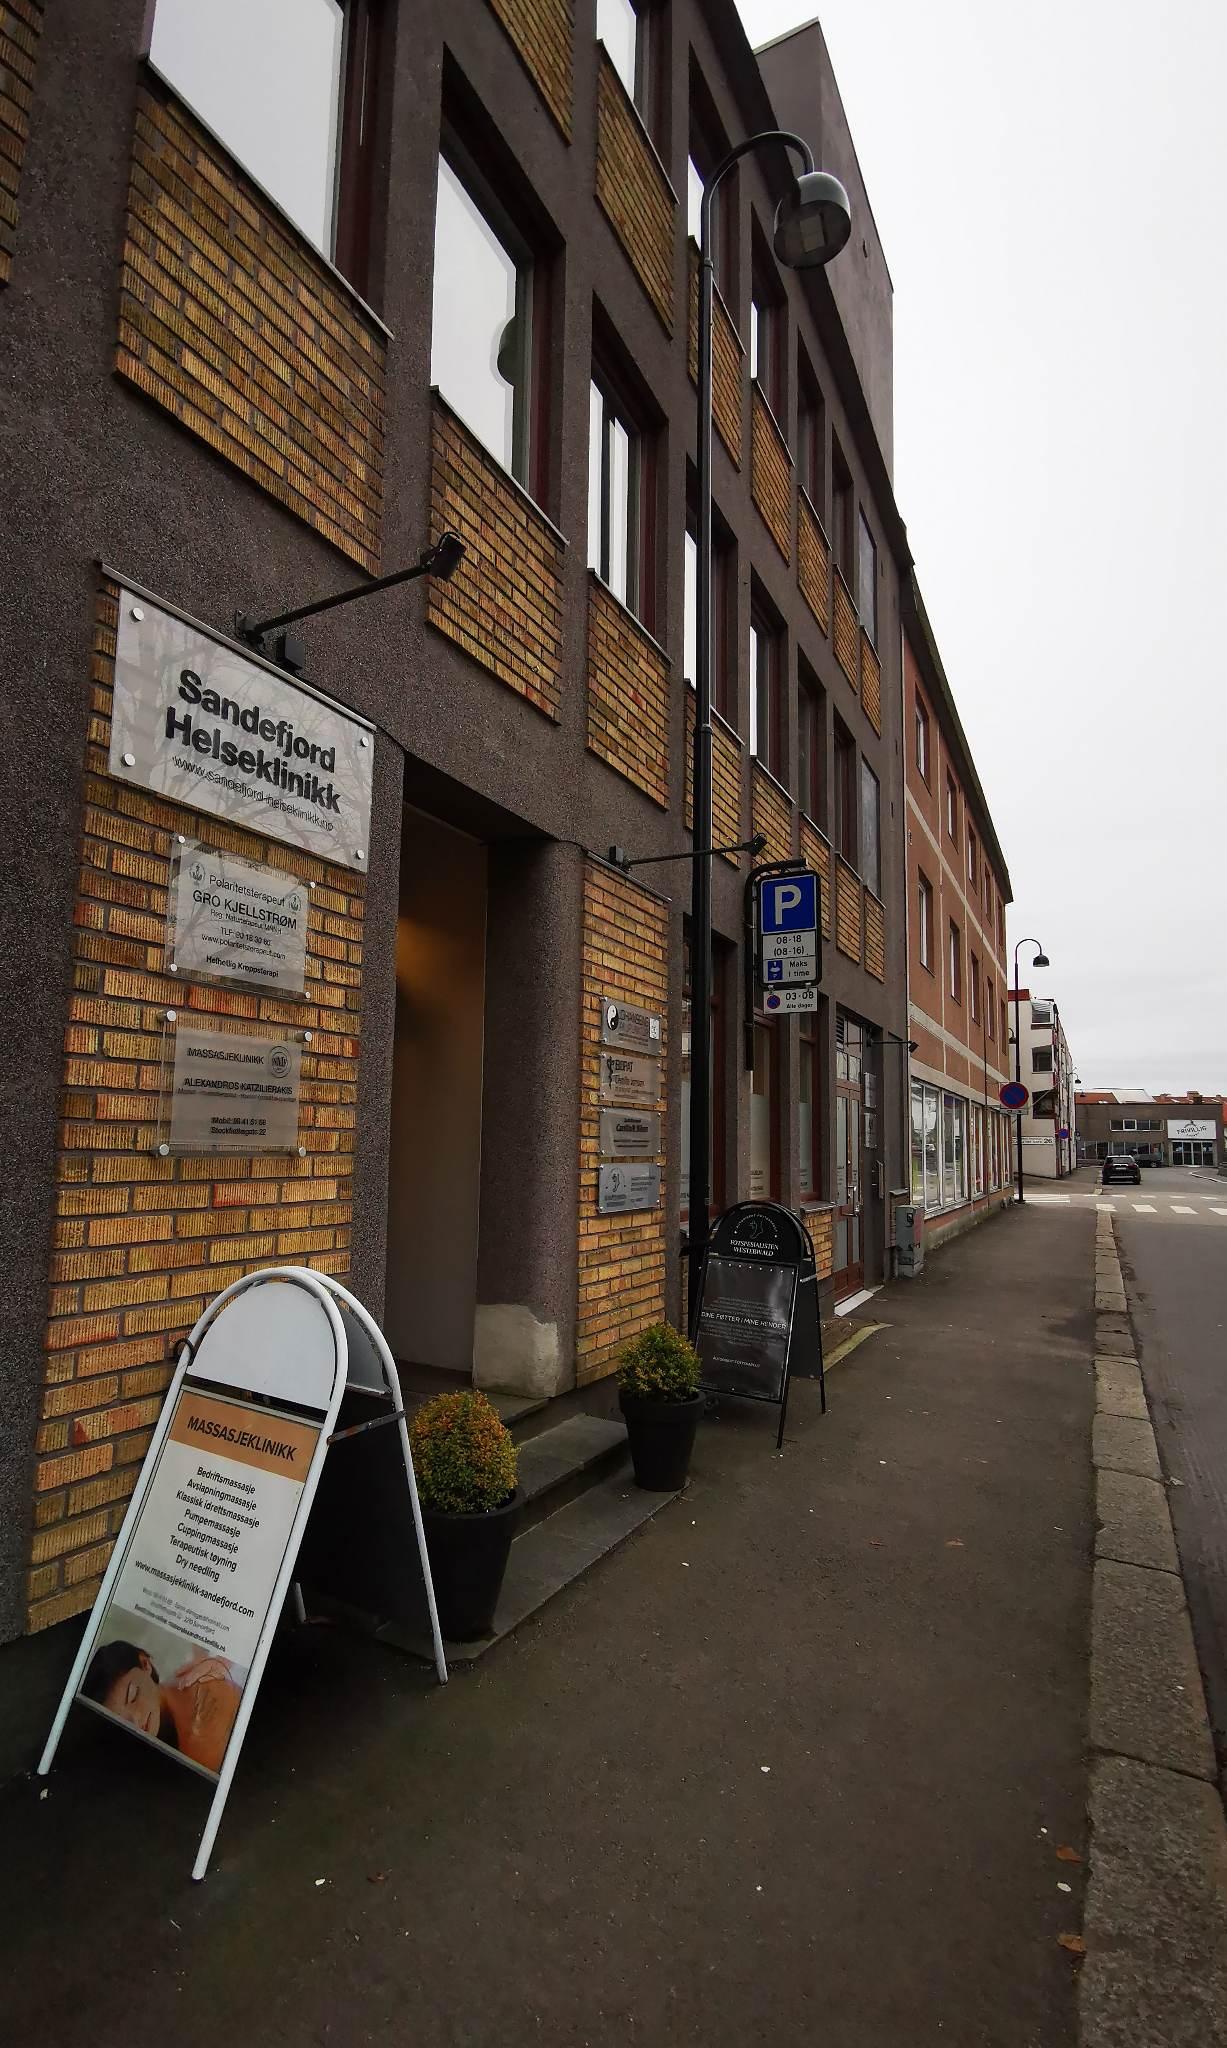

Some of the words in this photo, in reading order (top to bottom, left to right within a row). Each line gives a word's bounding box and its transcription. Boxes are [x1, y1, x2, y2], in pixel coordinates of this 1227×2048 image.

[178, 669, 336, 773] Sandefjord
[165, 706, 341, 813] Helseklinikk
[209, 874, 285, 908] Polaritetsterapeut
[775, 884, 802, 926] P
[192, 890, 220, 907] GRO
[225, 899, 297, 930] KJELLSTRØM
[789, 960, 808, 968] Maks
[187, 1047, 265, 1065] MASSASJEKLINIKK
[184, 1078, 240, 1090] ALEXANDROS
[187, 1416, 298, 1462] MASSASJEKLINIKK
[187, 1478, 257, 1511] Avslapningmassasje
[197, 1466, 256, 1494] Bedriftsmassasje
[176, 1490, 204, 1507] Klassisk
[204, 1502, 260, 1528] idrettsmassasje
[184, 1508, 241, 1537] Pumpemassasje
[170, 1535, 209, 1559] Terapeutisk
[209, 1550, 237, 1572] tøyning
[177, 1522, 239, 1554] Cuppingmassasje
[176, 1554, 188, 1569] Dry
[188, 1562, 220, 1582] needling
[135, 1559, 255, 1618] www.massasjeklinikk-sandefjord.com
